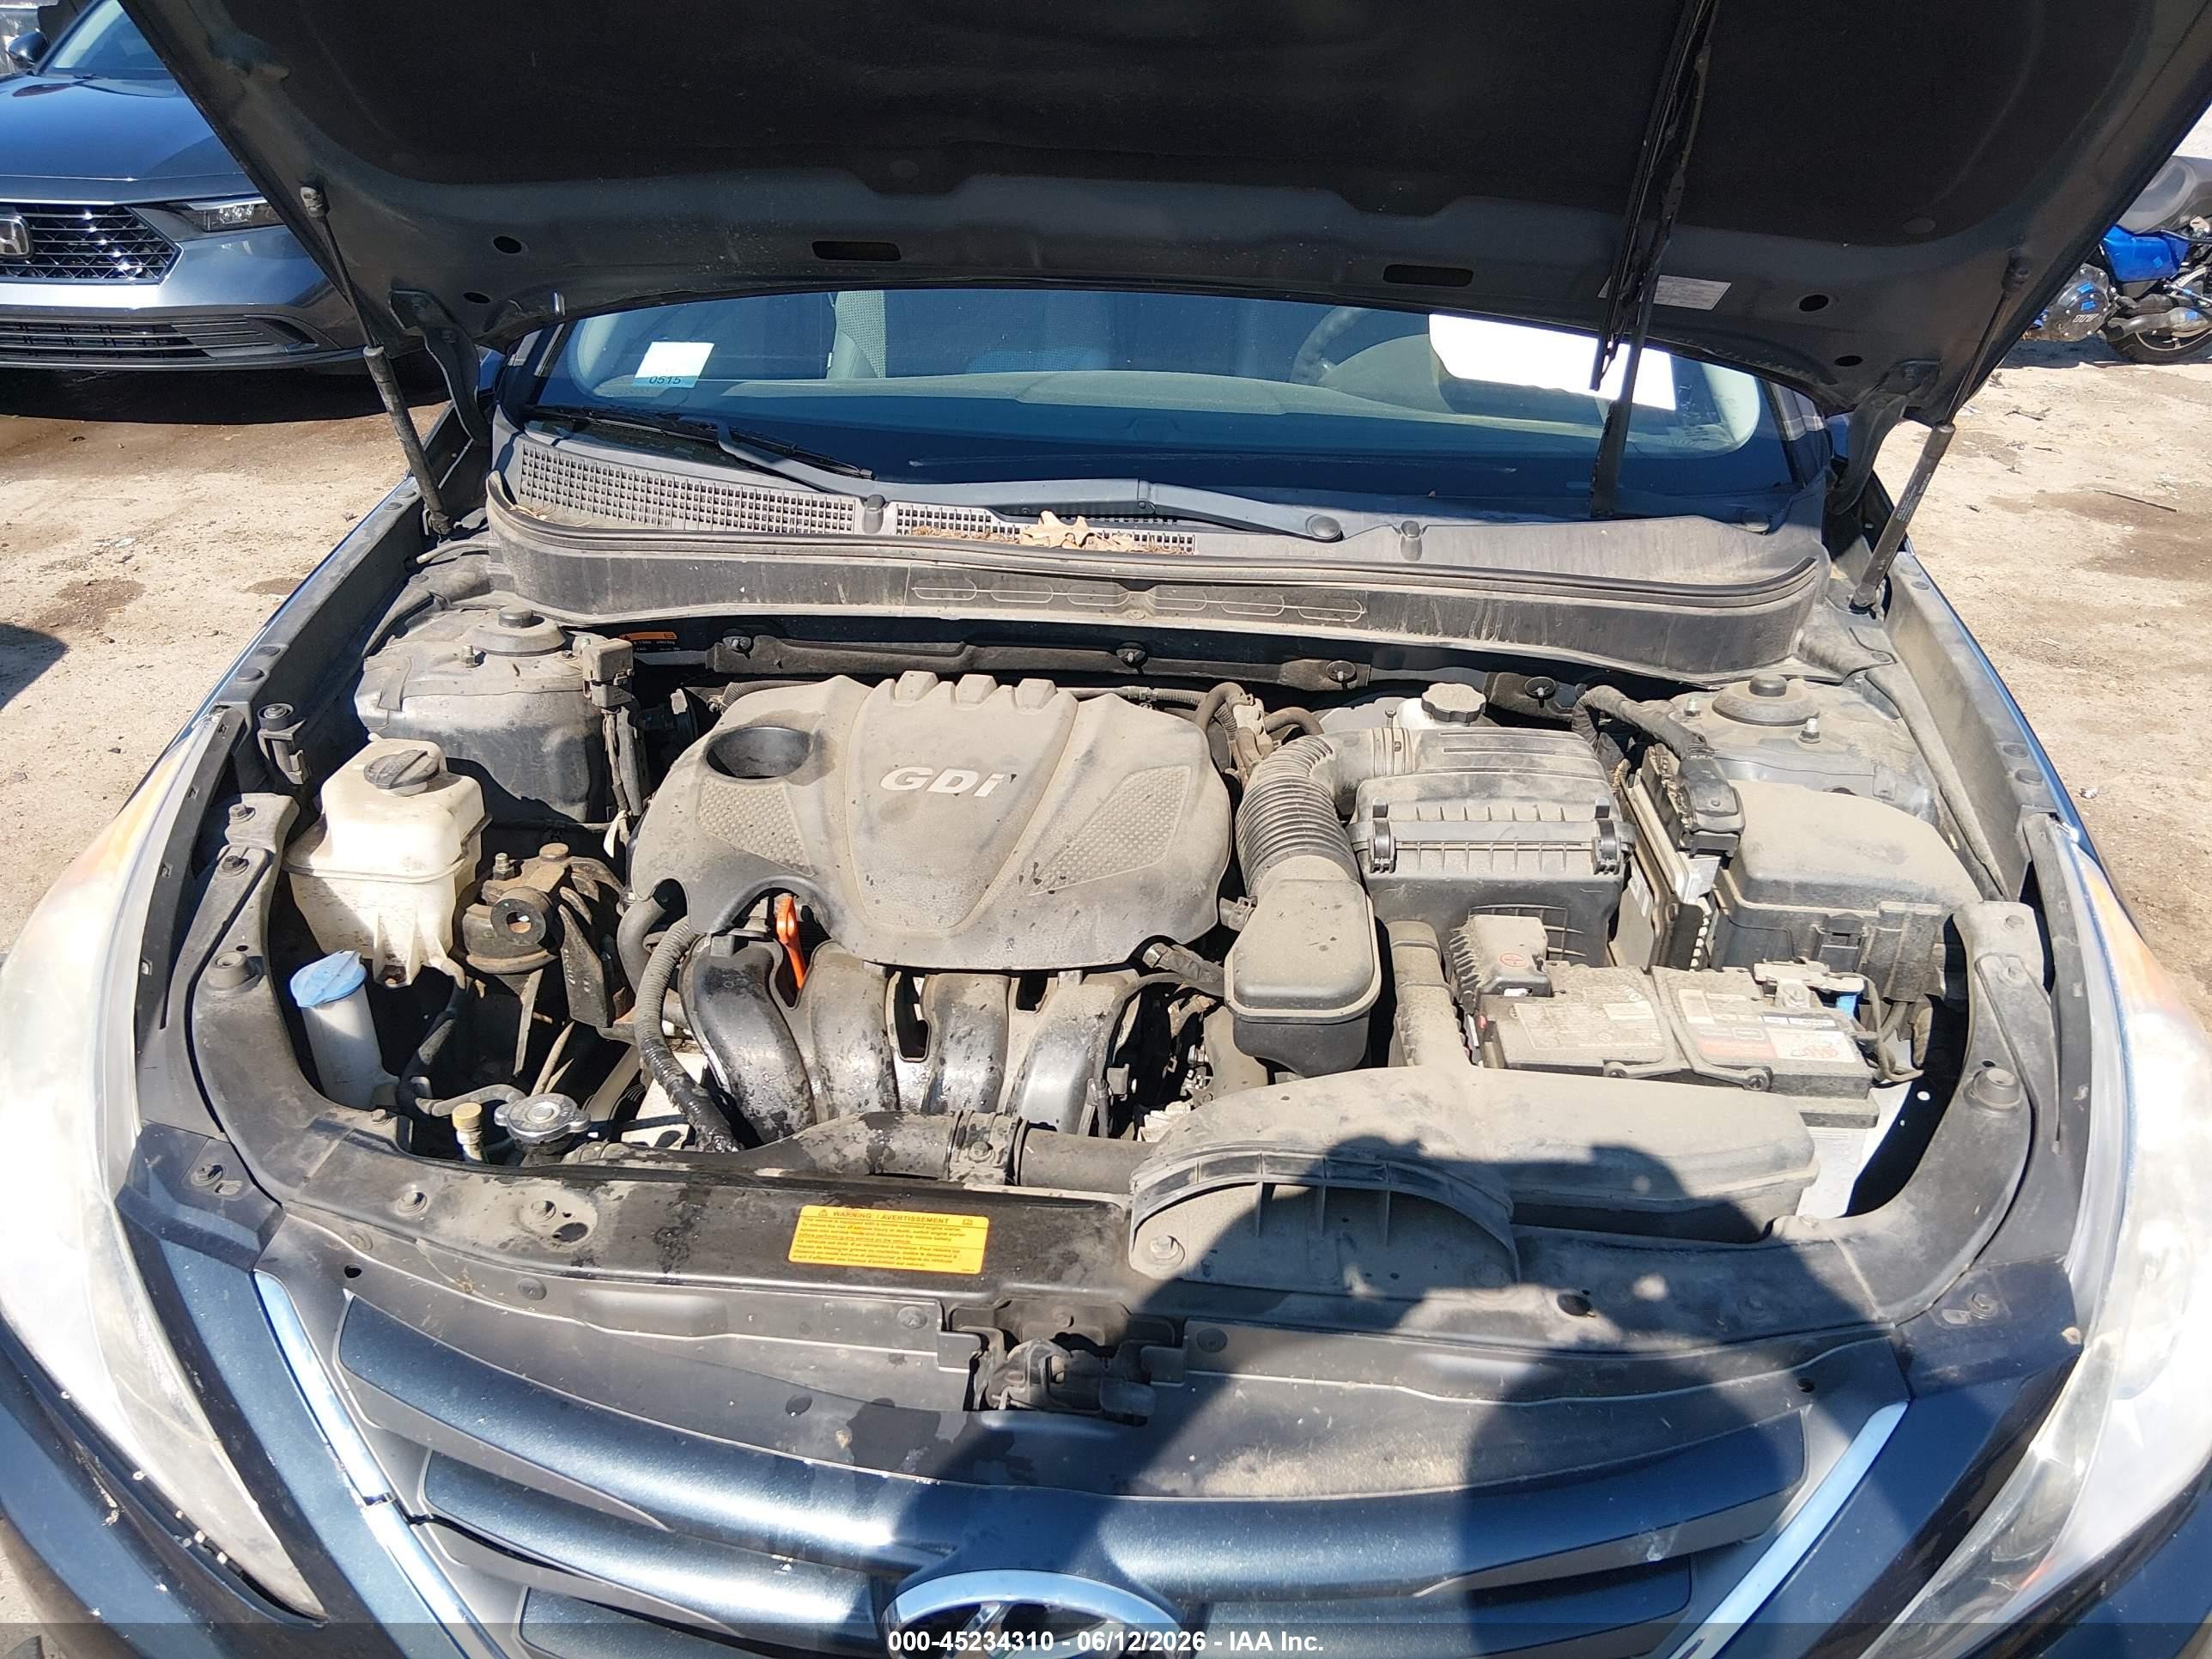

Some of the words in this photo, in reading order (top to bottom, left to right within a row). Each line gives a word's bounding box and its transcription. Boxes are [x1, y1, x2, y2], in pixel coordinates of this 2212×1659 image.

[649, 375, 682, 385] 0515
[879, 766, 1006, 798] GDi
[832, 1210, 872, 1219] WARNING
[880, 1214, 950, 1224] AVERTISSEMENT
